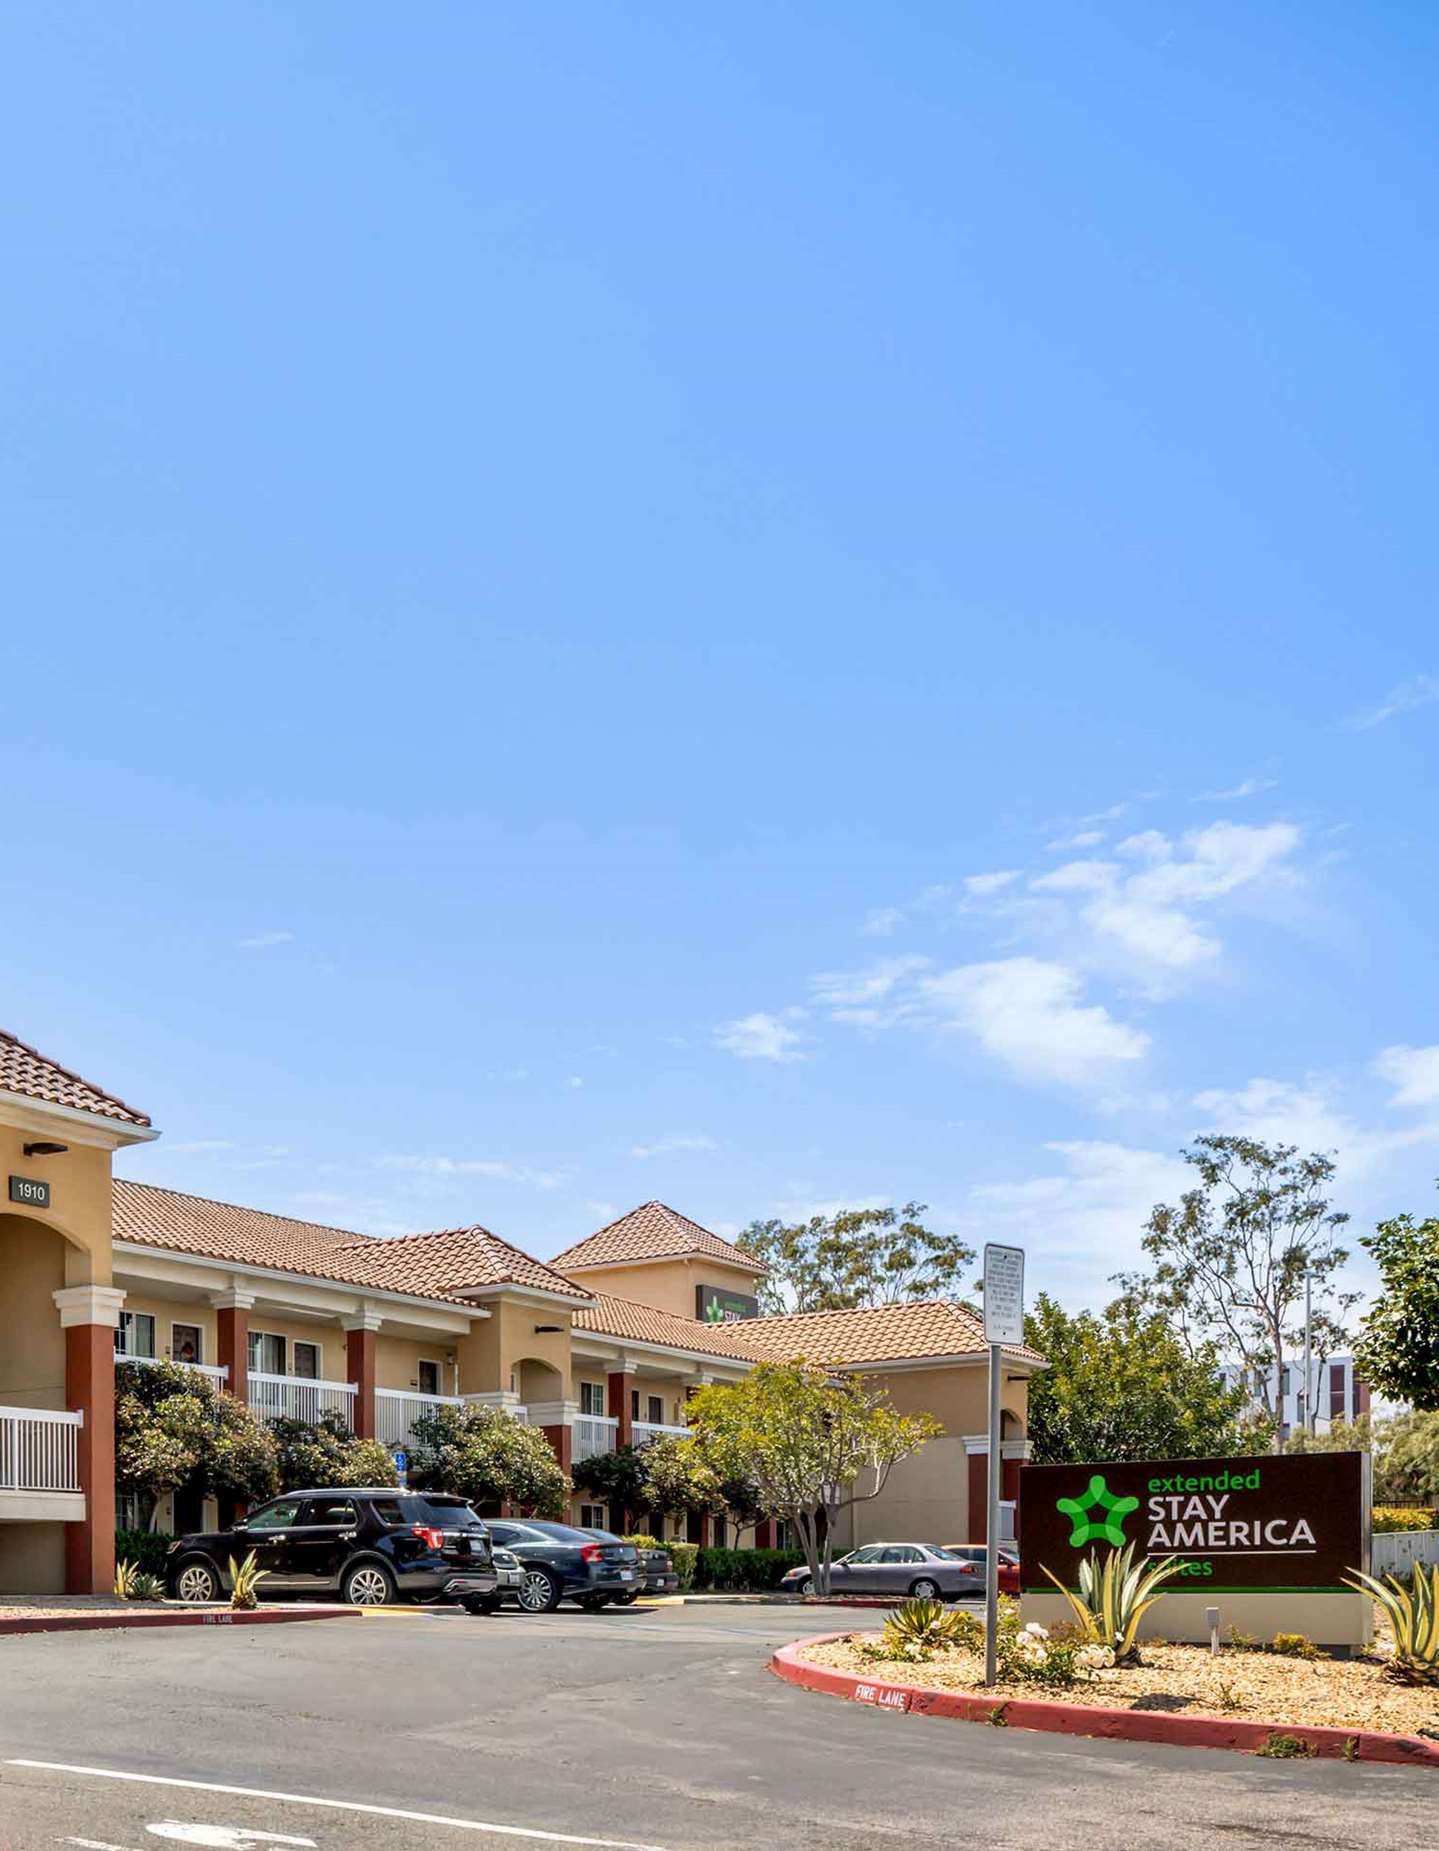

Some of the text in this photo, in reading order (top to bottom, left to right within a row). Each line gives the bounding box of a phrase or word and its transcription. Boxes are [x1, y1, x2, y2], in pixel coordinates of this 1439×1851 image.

[18, 1183, 45, 1200] 1910
[1147, 1469, 1261, 1493] extended
[1147, 1494, 1231, 1522] STAY
[1147, 1519, 1316, 1548] AMERICA
[855, 1683, 907, 1706] FIRE LANE
